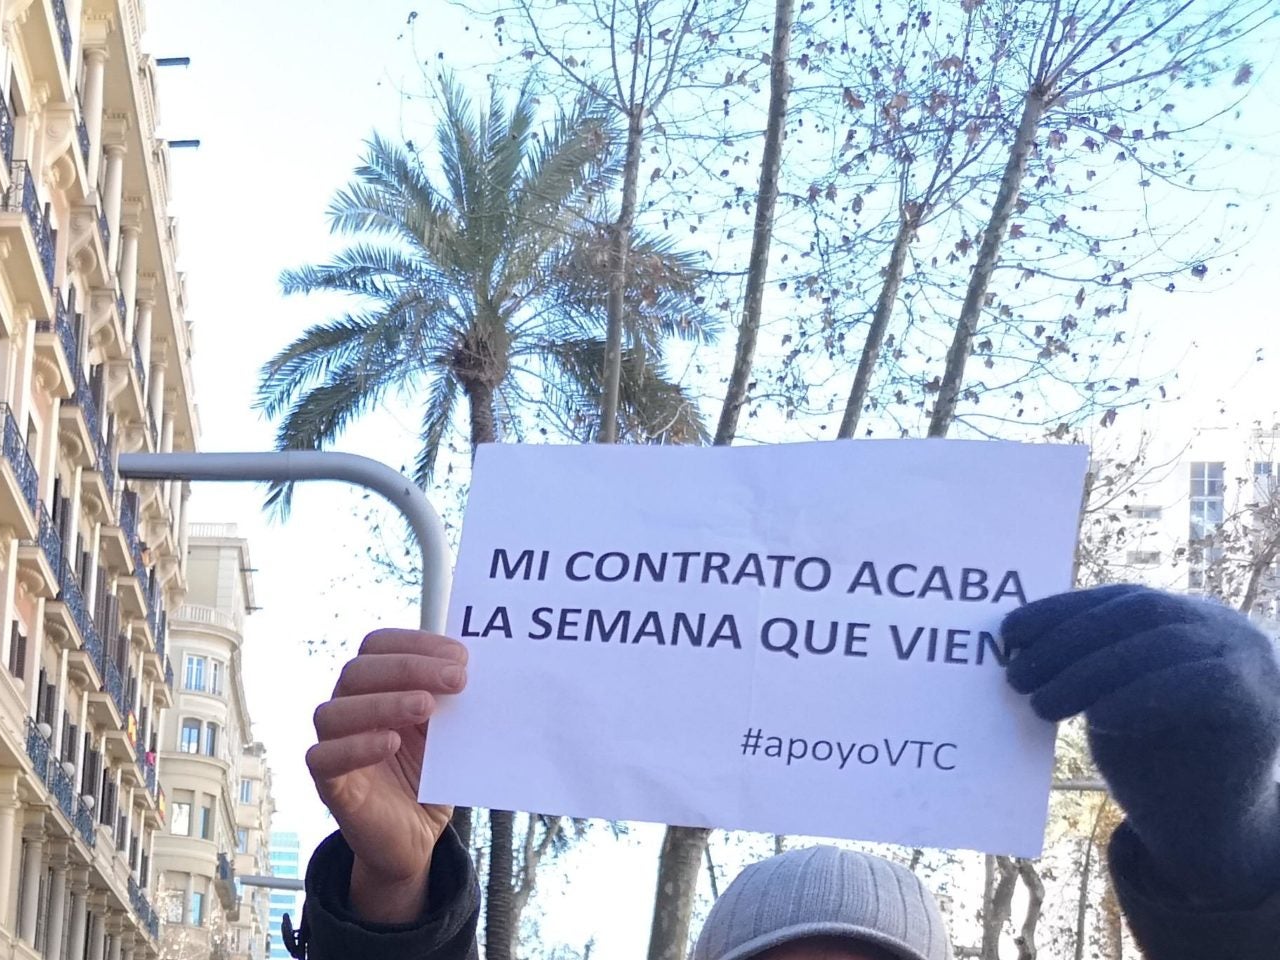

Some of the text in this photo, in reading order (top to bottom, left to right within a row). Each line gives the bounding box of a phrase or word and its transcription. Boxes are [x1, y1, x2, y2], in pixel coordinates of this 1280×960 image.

[488, 548, 1028, 606] MI CONTRATO ACABA
[460, 605, 1011, 667] LA SEMANA QUE VIEN
[740, 727, 958, 771] #apoyoVTC
